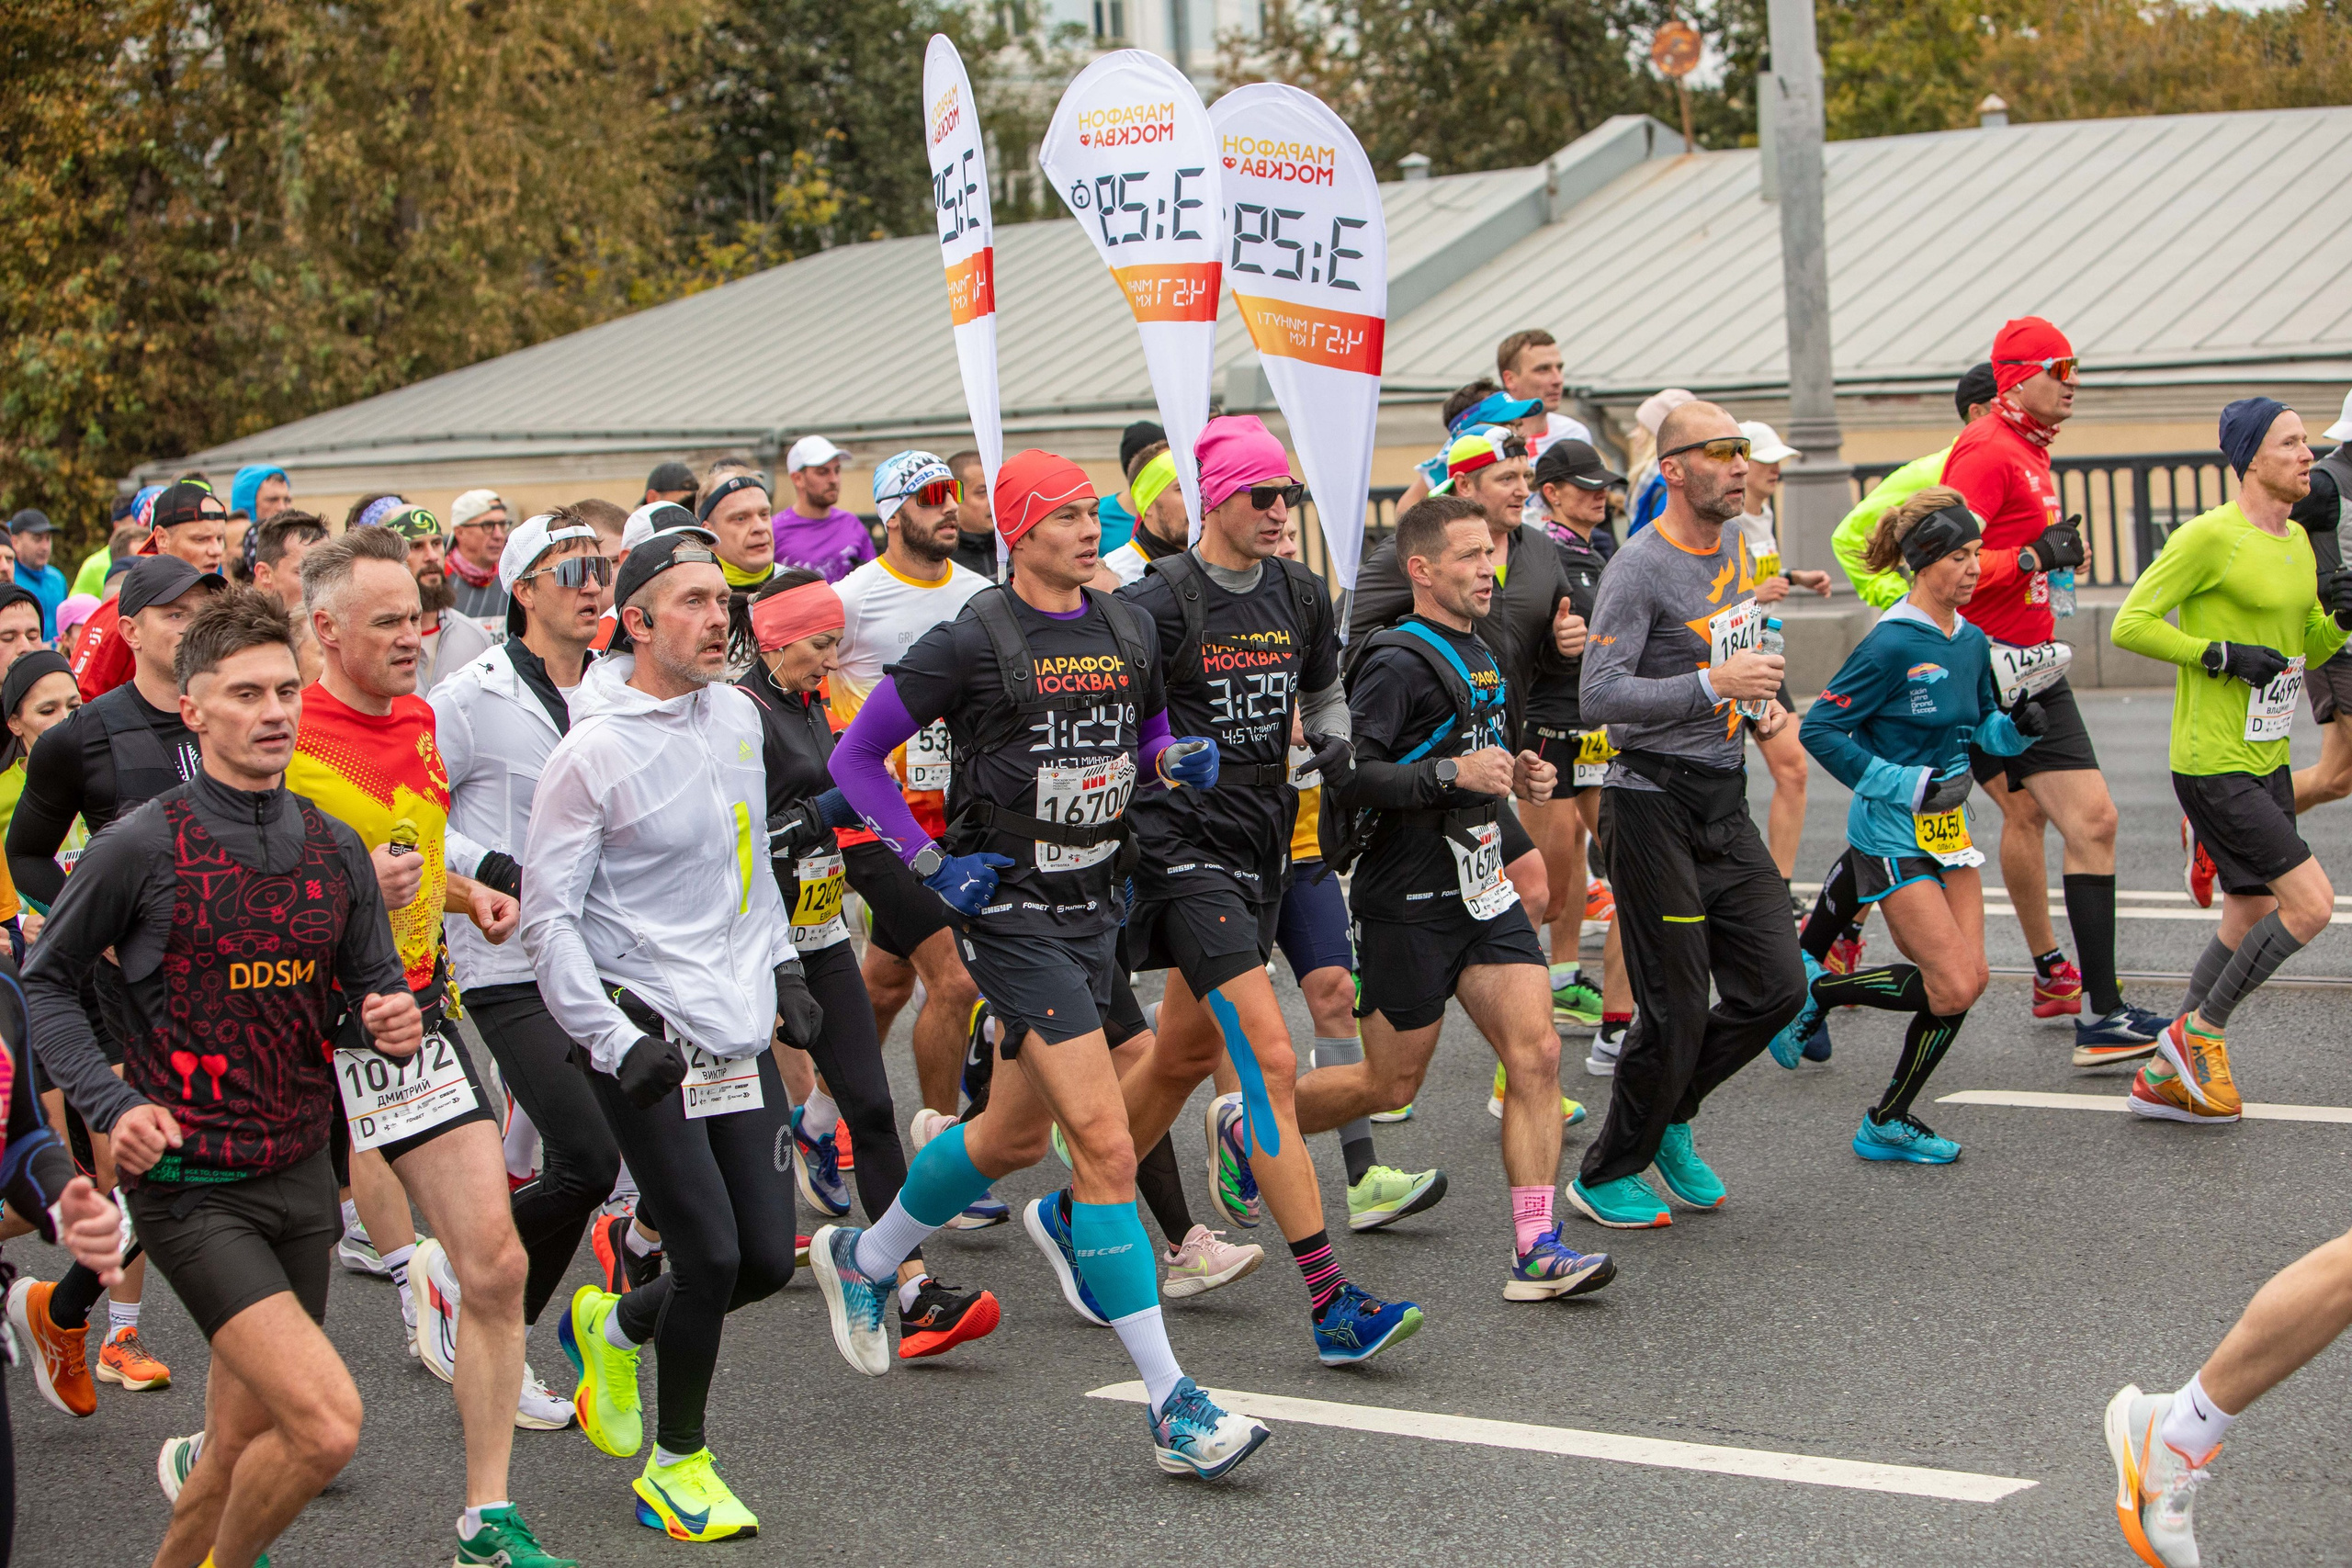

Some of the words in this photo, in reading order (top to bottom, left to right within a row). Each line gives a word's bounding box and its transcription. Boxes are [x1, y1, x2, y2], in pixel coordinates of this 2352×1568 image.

[1204, 651, 1282, 673] МОСКВА
[1207, 671, 1288, 723] 3:29
[2252, 717, 2263, 732] D
[915, 768, 926, 782] D
[1047, 844, 1061, 861] D
[1167, 863, 1196, 874] СИБУР
[1406, 892, 1434, 900] СИБУР
[981, 903, 1012, 915] СИБУР
[1022, 901, 1049, 911] FONBET
[795, 926, 807, 942] D
[229, 959, 316, 990] DDSM
[377, 1077, 432, 1108] ДМИТРИЙ
[689, 1088, 697, 1107] D
[359, 1117, 376, 1139] D
